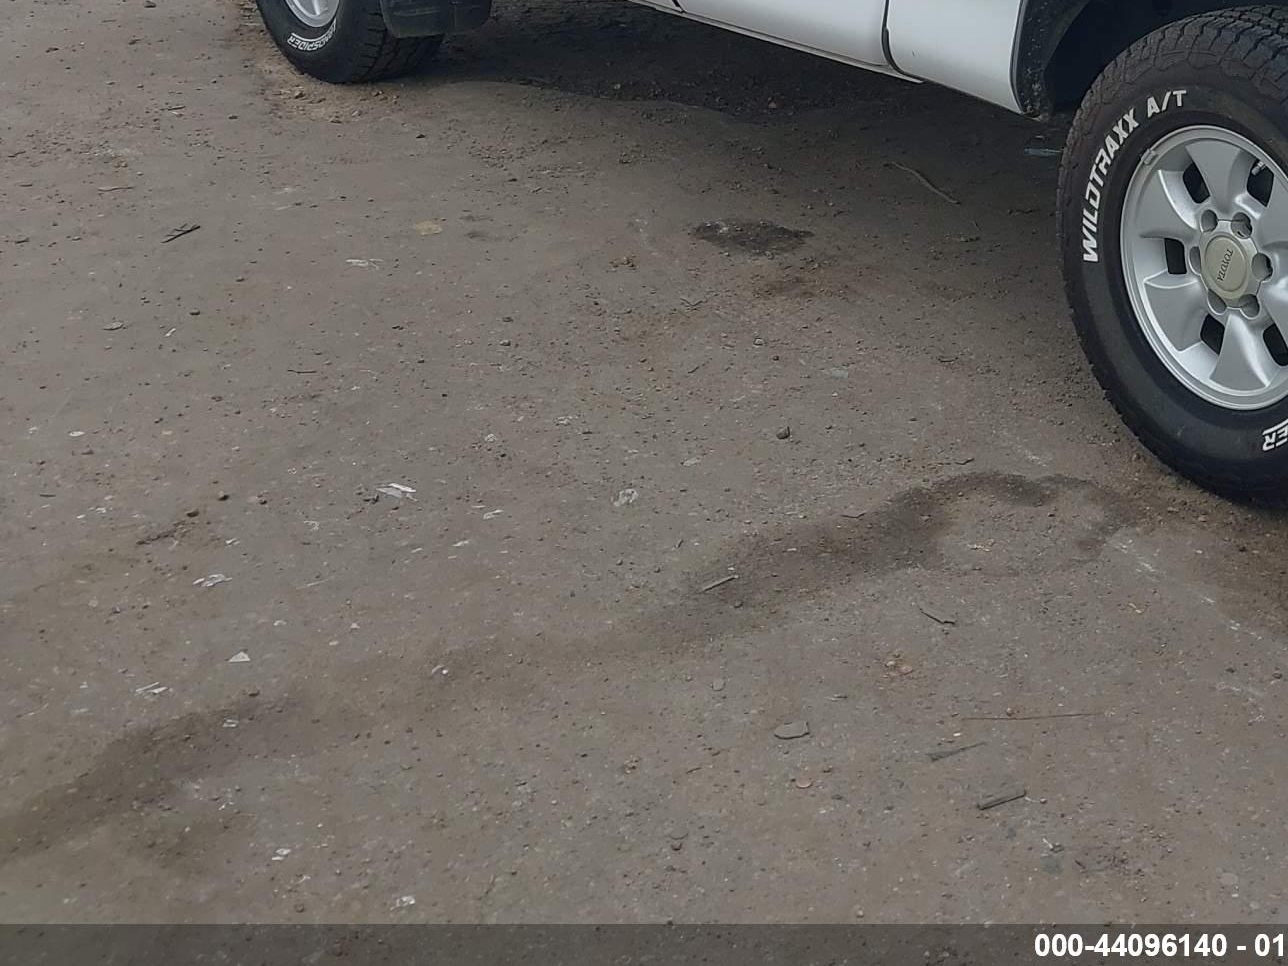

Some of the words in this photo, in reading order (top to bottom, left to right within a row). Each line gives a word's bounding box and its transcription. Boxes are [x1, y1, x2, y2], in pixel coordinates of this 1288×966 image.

[1082, 108, 1140, 263] WILDTRAXX
[1146, 89, 1188, 118] A/T
[1217, 249, 1234, 281] TOYOTA
